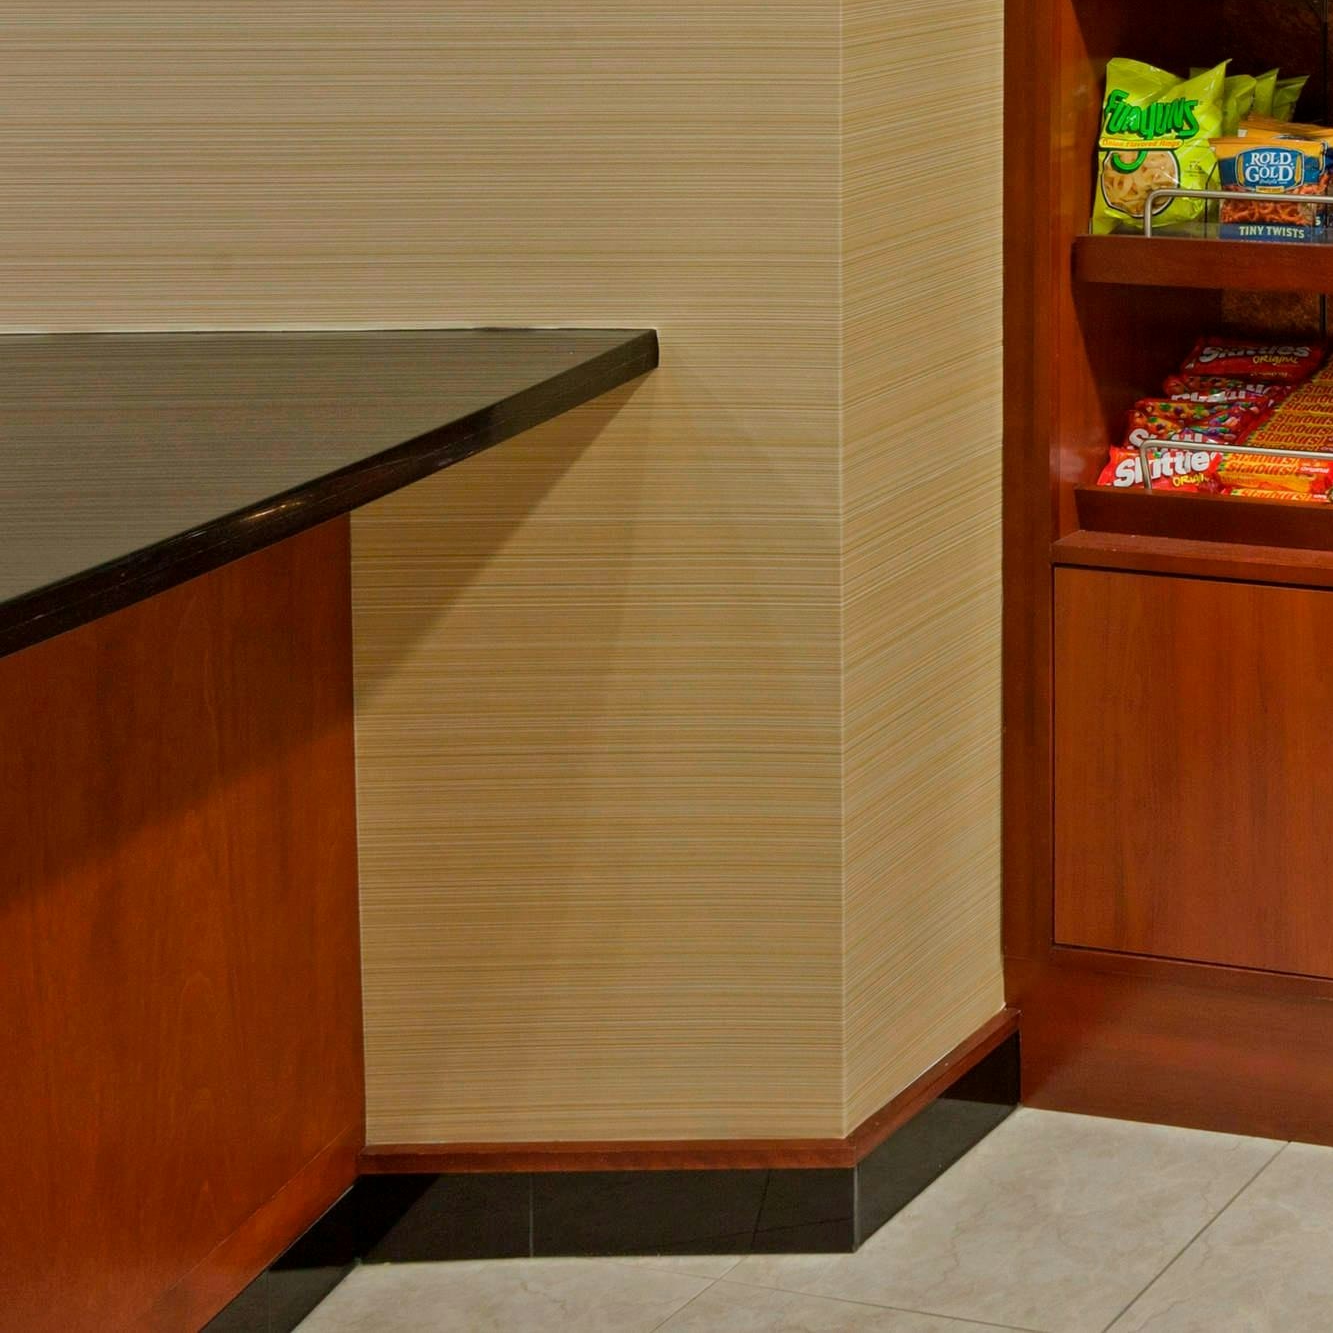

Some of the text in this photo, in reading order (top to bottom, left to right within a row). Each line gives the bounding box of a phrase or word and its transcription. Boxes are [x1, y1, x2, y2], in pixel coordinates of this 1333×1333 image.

[1251, 152, 1292, 165] ROLD
[1245, 166, 1295, 183] GOLD
[1239, 225, 1305, 239] TINY TWISTS
[1114, 451, 1213, 489] Skittle
